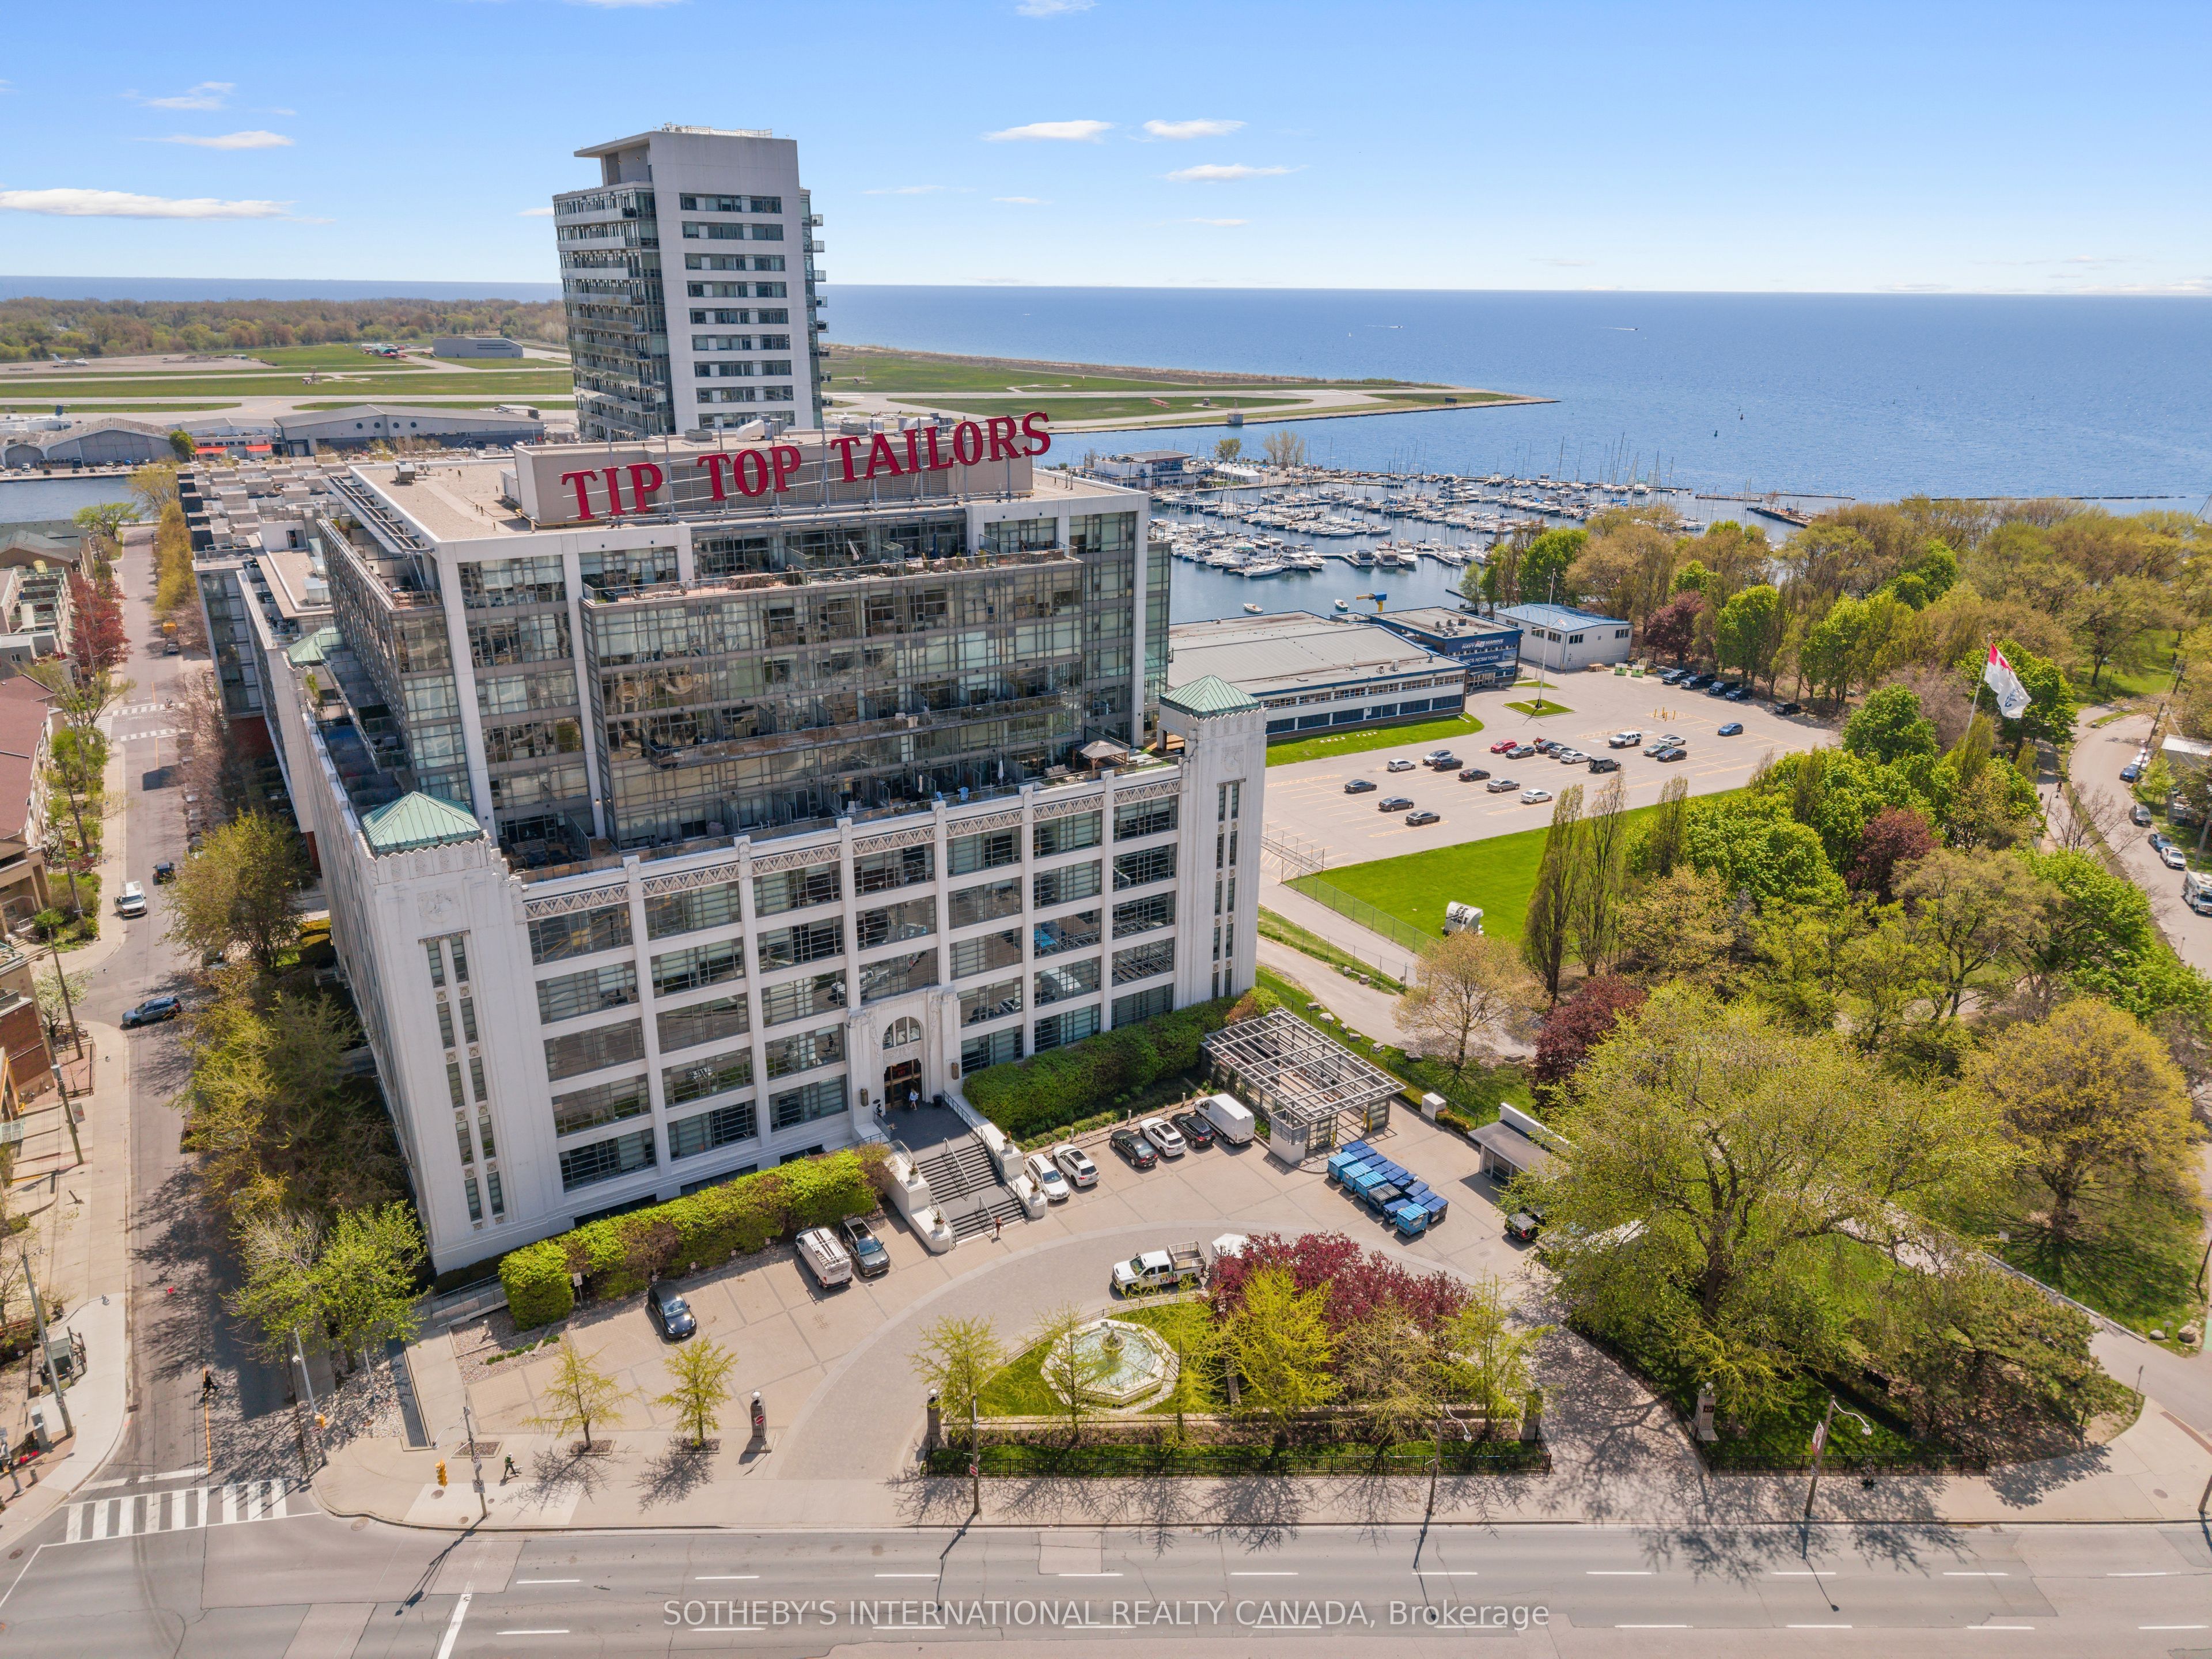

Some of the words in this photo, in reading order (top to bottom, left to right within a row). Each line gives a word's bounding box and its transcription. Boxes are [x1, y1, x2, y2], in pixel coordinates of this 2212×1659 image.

[562, 463, 663, 520] TIP
[697, 445, 802, 502] TOP
[830, 411, 1051, 483] TAILORS
